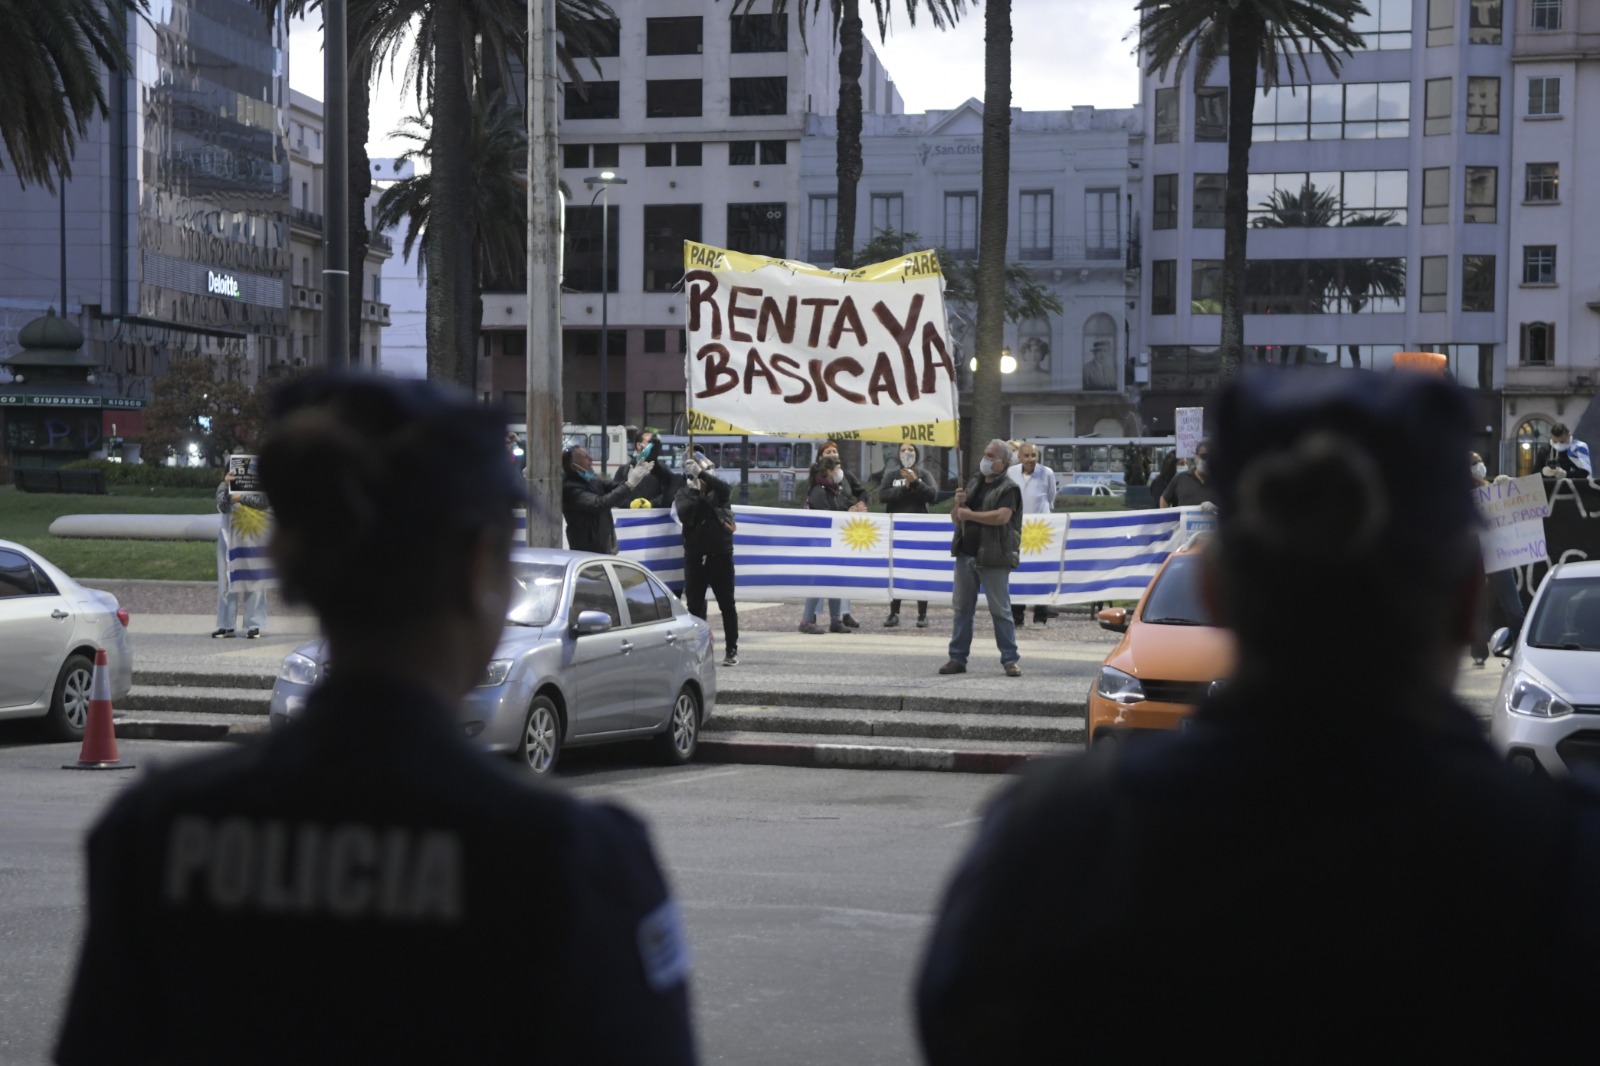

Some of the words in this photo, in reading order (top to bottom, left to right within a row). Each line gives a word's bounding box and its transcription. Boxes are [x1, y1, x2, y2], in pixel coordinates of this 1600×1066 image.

[935, 145, 954, 155] San
[957, 144, 982, 155] Crist
[904, 254, 938, 276] PARE
[685, 270, 868, 349] RENTA
[872, 293, 956, 401] YA
[695, 342, 904, 406] BASICA
[33, 396, 94, 405] CIUDADELA
[108, 399, 142, 407] KIOSCO
[901, 424, 935, 441] PARE
[1528, 538, 1547, 559] NO
[165, 815, 463, 922] POLICIA
